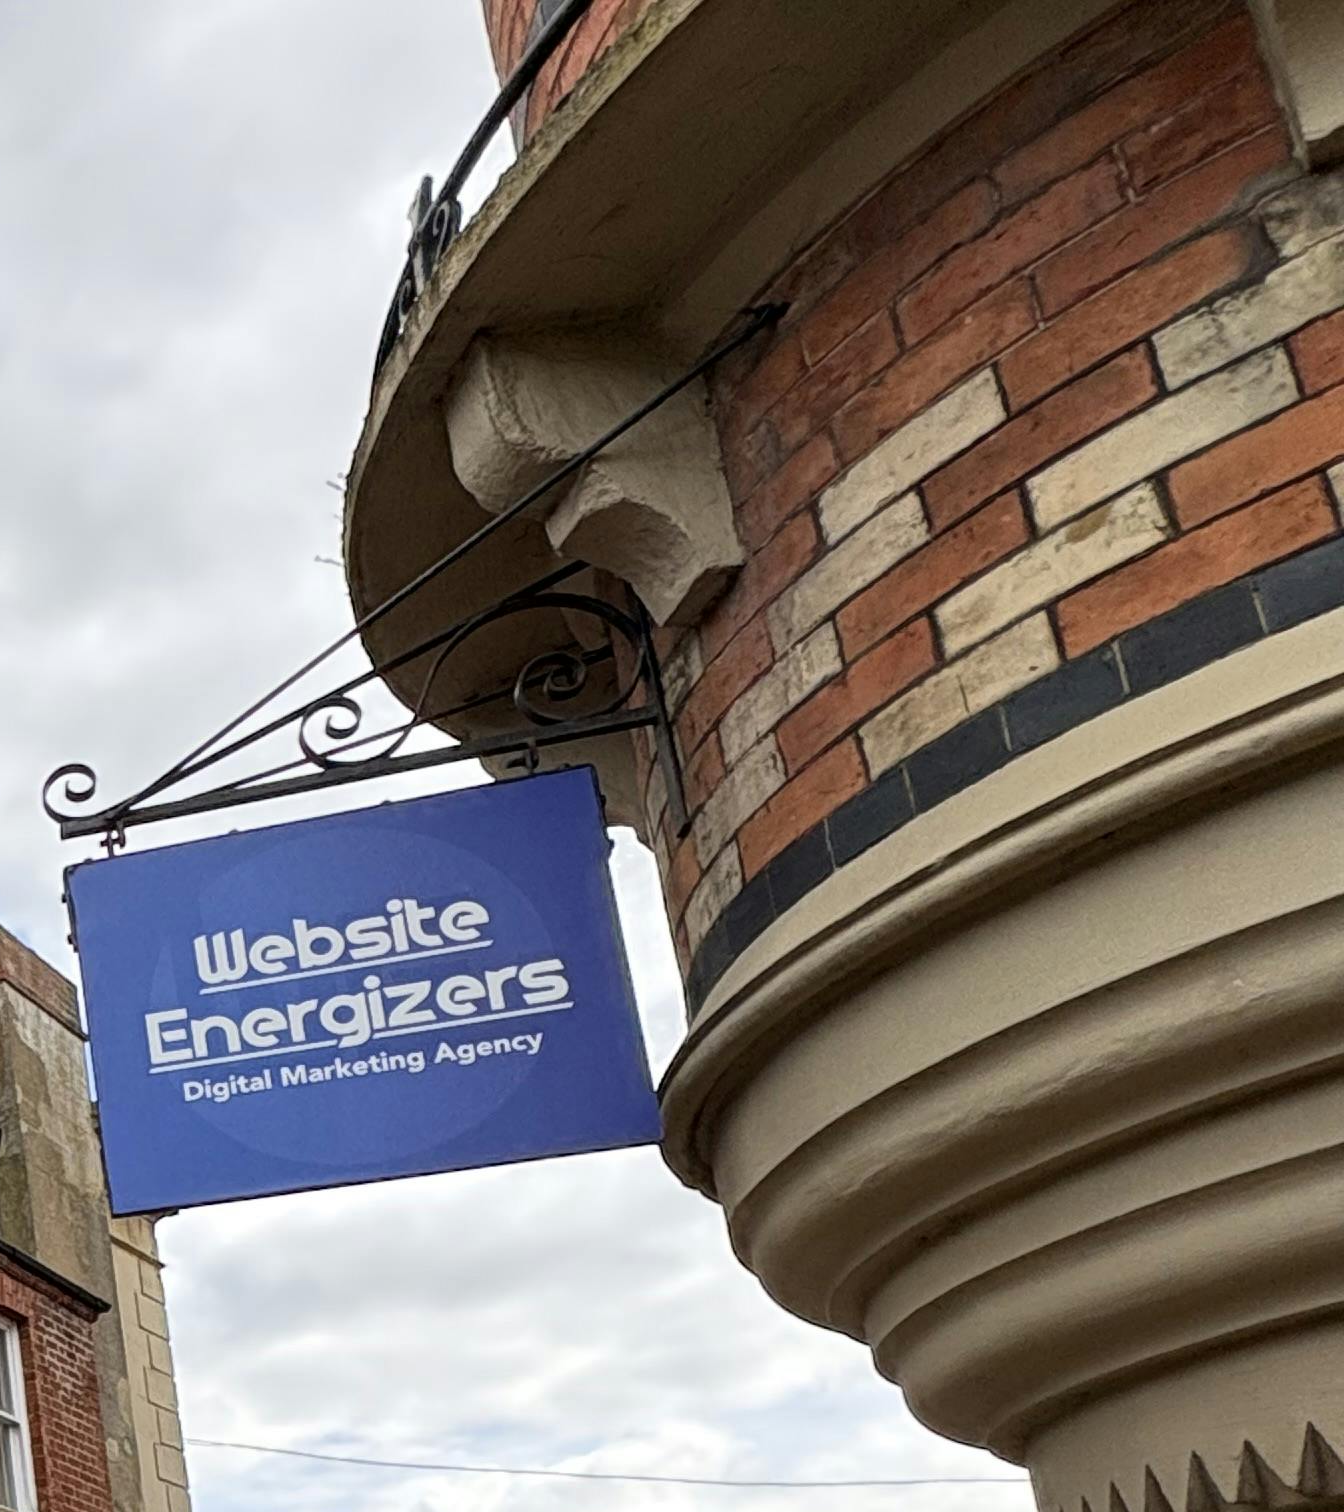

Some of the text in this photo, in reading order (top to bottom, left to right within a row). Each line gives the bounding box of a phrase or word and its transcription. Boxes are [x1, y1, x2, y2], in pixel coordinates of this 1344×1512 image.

[193, 898, 490, 985] Website
[144, 958, 571, 1066] Energizers
[183, 1032, 544, 1104] Digital Marketing Agency
